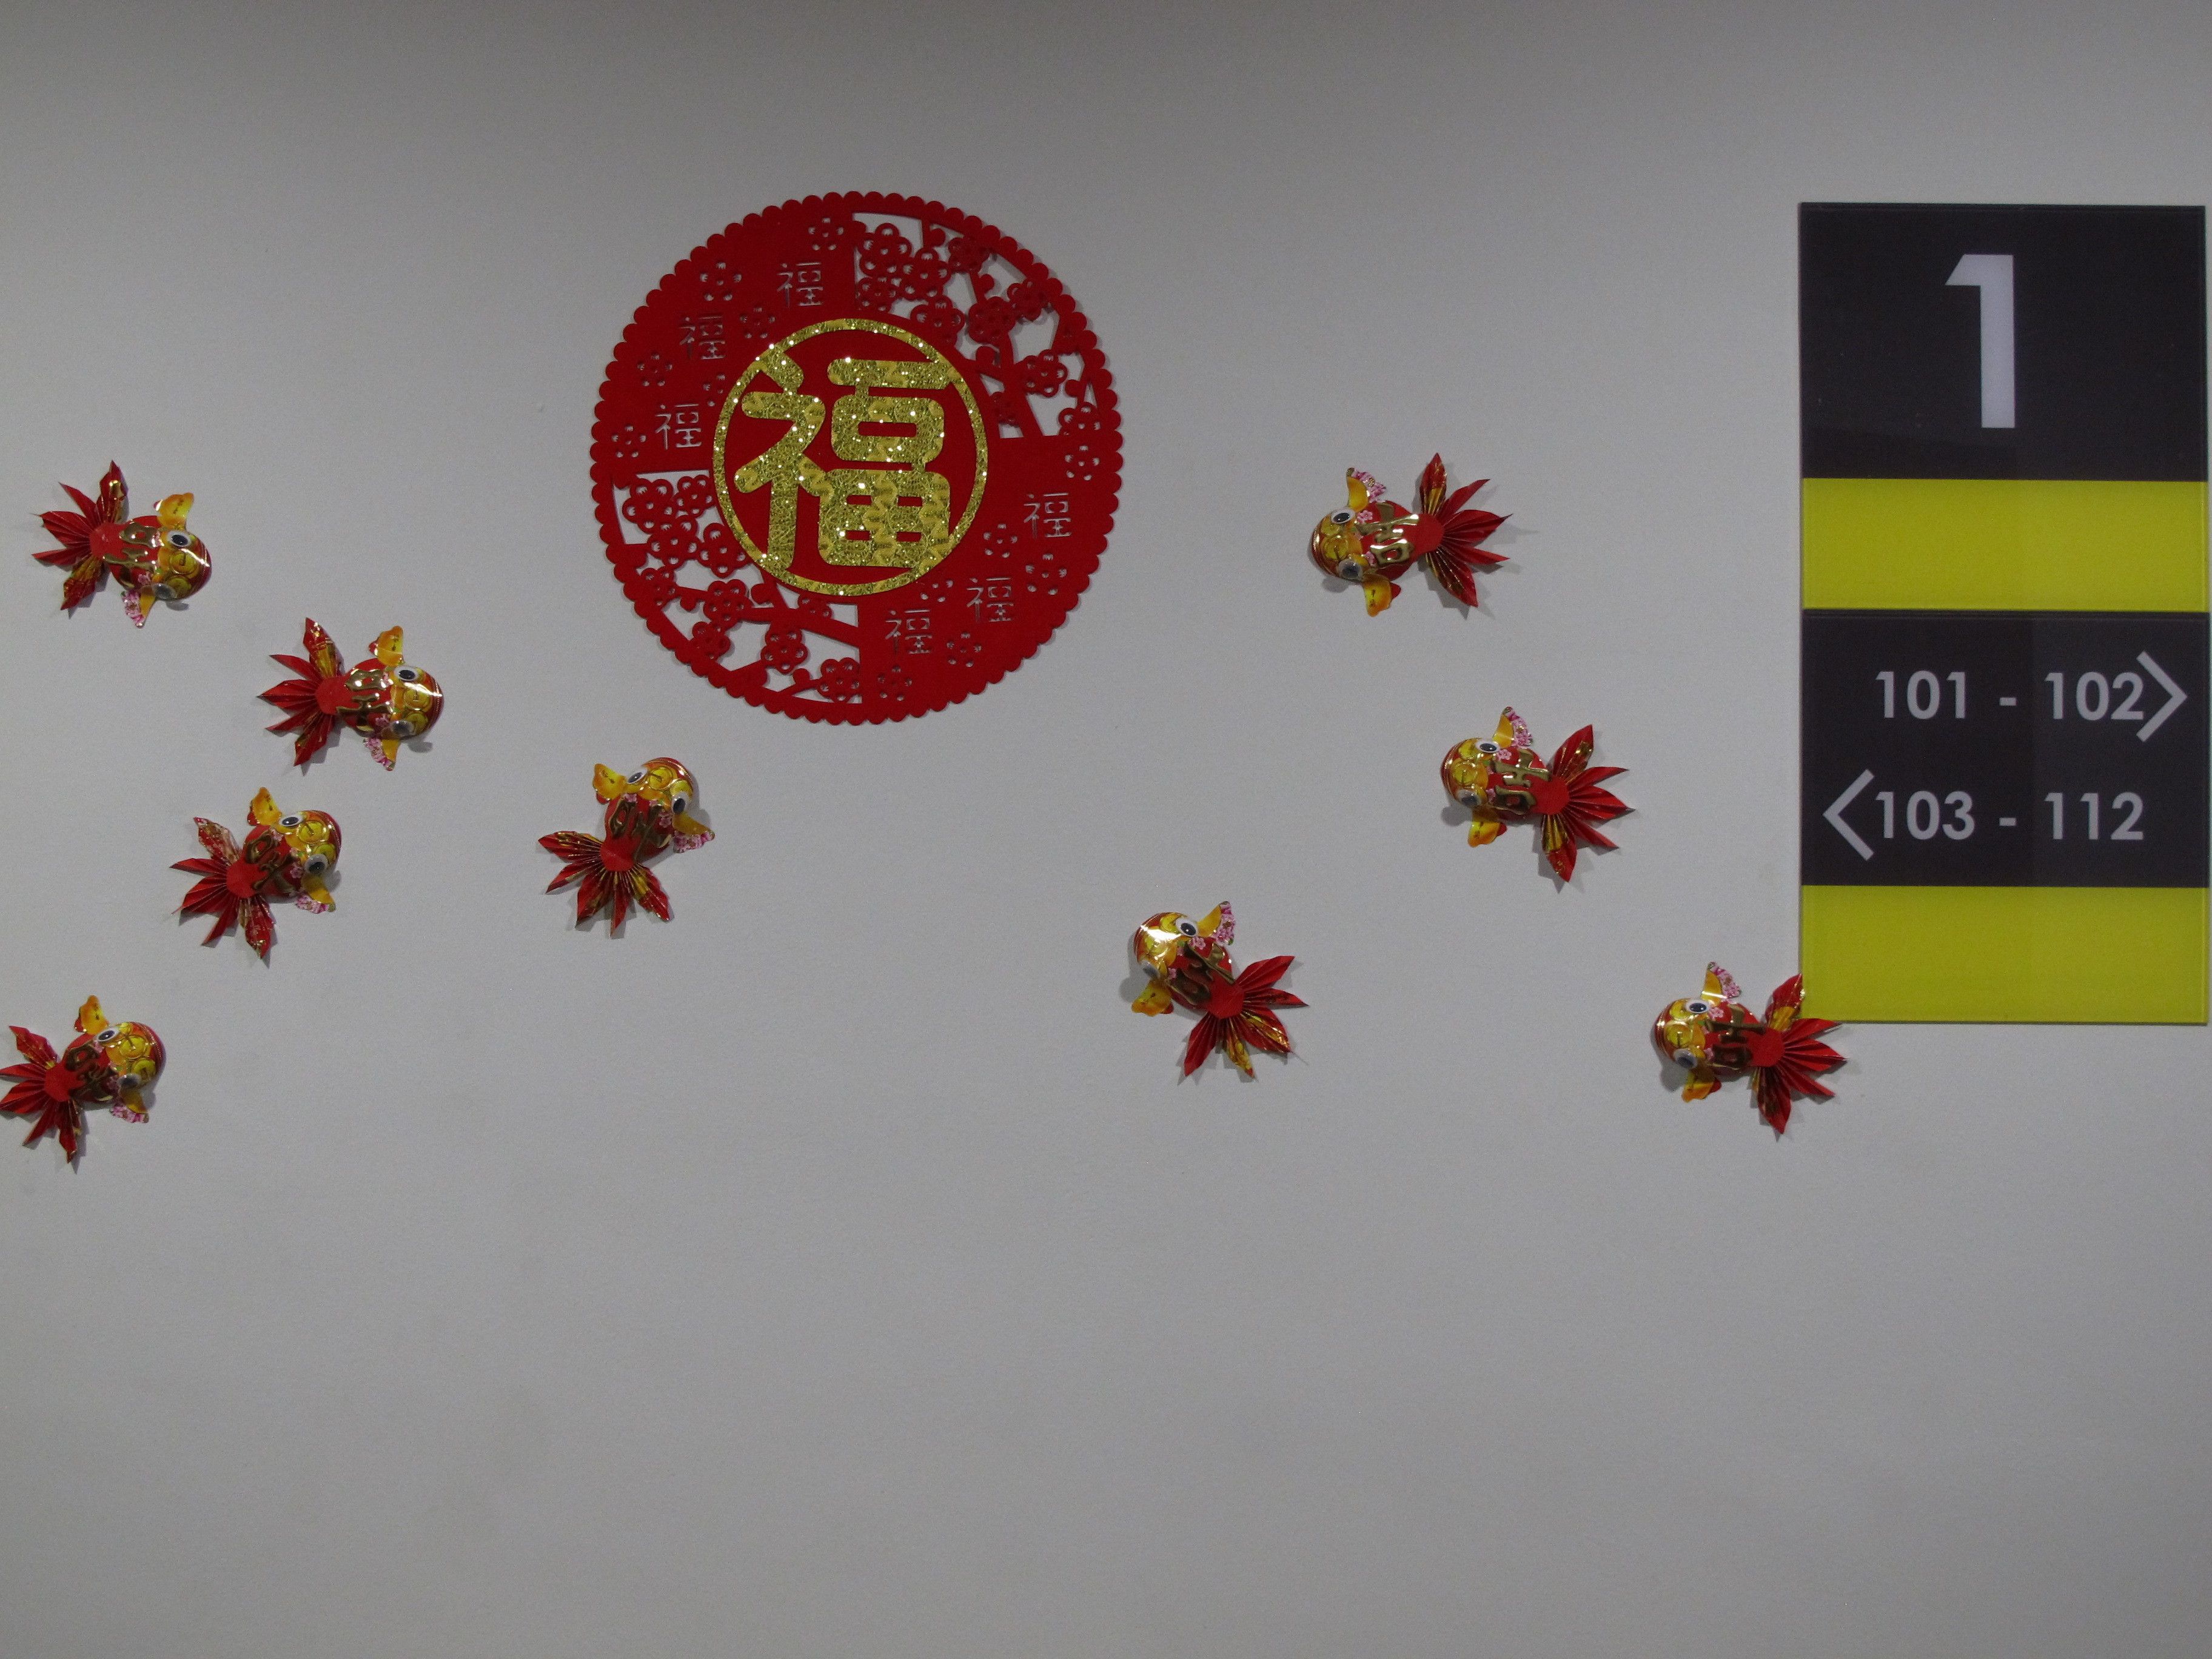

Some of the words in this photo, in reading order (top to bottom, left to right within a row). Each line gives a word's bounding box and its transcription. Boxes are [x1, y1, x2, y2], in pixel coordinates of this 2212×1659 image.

[777, 260, 824, 307] 福
[679, 314, 727, 361] 福
[1945, 253, 2016, 429] 1
[654, 403, 703, 450] 福
[734, 347, 959, 570] 福
[1023, 492, 1071, 539] 福
[967, 576, 1013, 624] 福
[885, 608, 933, 655] 福
[1875, 670, 1967, 720] 101
[2044, 671, 2145, 721] 102
[1875, 791, 1976, 840] 103
[2044, 792, 2145, 840] 112
